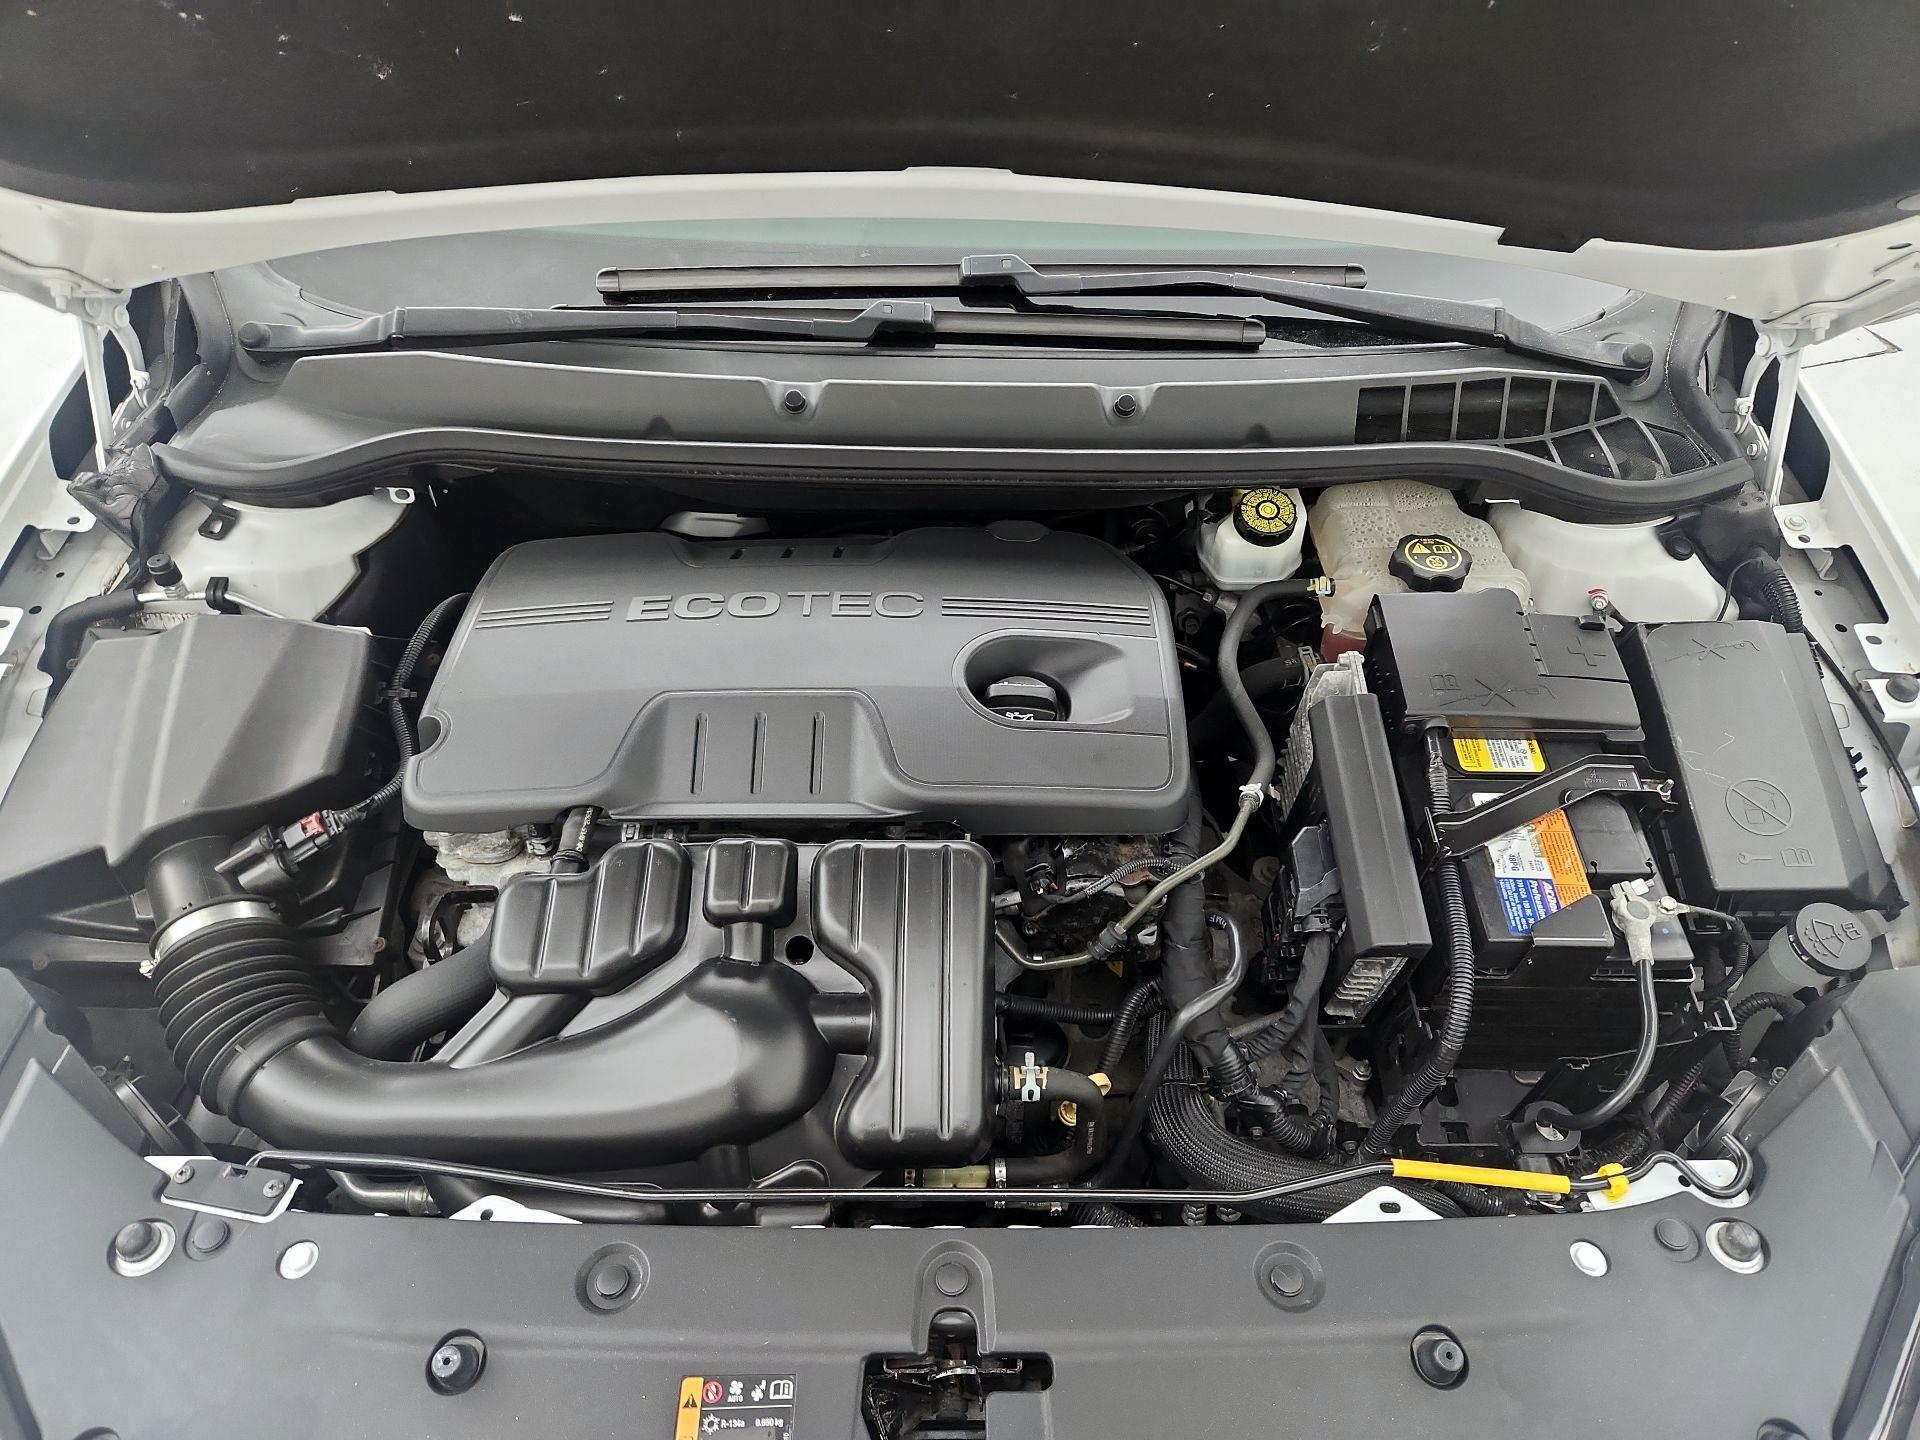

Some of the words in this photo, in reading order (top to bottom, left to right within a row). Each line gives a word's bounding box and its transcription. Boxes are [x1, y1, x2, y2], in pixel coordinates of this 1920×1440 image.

[625, 590, 925, 623] ECOTEC
[727, 1394, 744, 1403] AUTO
[720, 1418, 745, 1429] R-134a
[774, 1417, 784, 1428] kg
